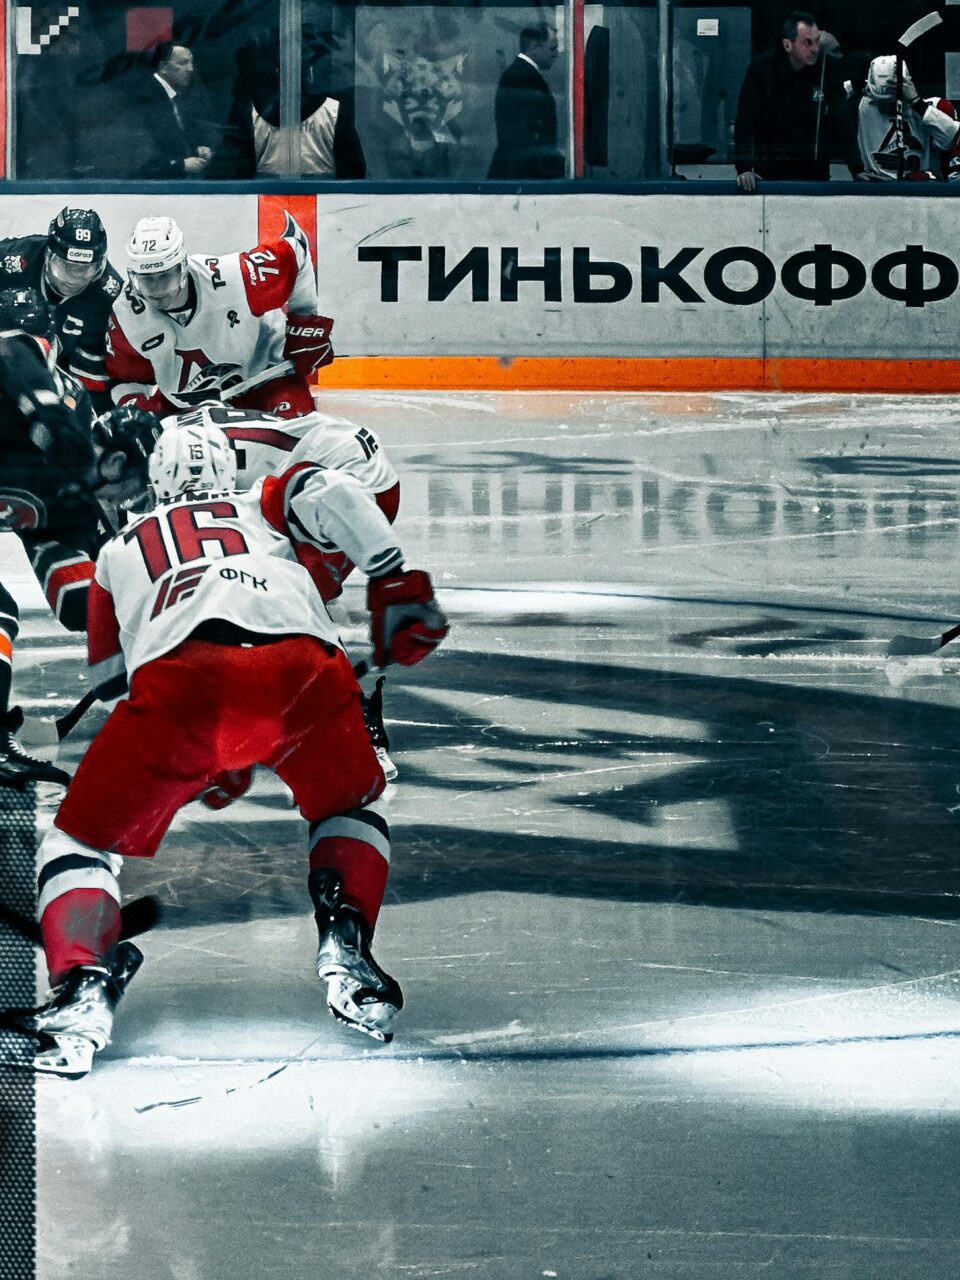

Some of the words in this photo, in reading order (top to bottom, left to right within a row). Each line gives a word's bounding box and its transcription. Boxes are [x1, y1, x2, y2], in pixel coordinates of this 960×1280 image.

[75, 229, 91, 241] 89
[142, 240, 156, 252] 72
[248, 249, 279, 282] 72
[358, 244, 960, 307] ТИНЬКОФФ
[123, 500, 250, 585] 16
[219, 569, 269, 592] ФГК
